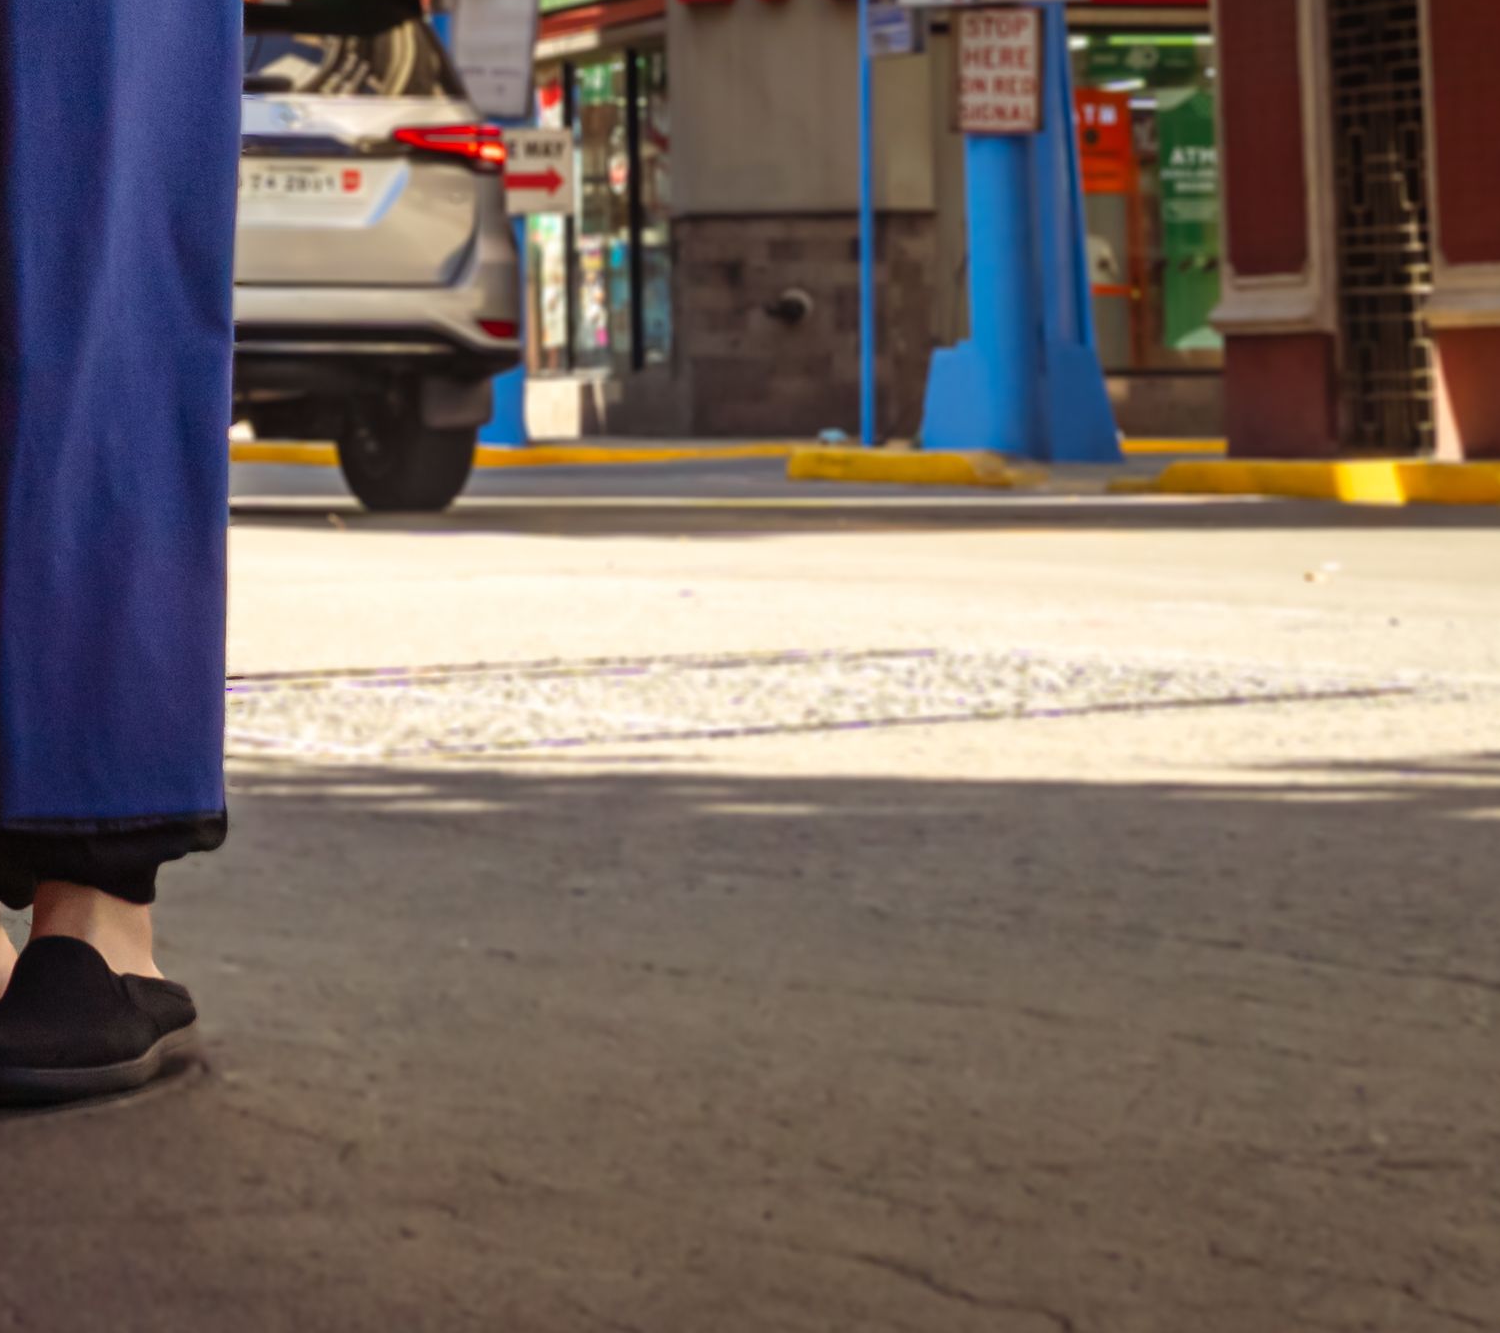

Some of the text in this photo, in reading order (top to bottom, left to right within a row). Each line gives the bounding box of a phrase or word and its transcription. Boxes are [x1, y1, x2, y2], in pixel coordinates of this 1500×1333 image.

[965, 16, 1029, 38] STOP
[963, 45, 1029, 69] HERE
[995, 75, 1037, 94] RED
[959, 102, 1034, 122] SIGNAL
